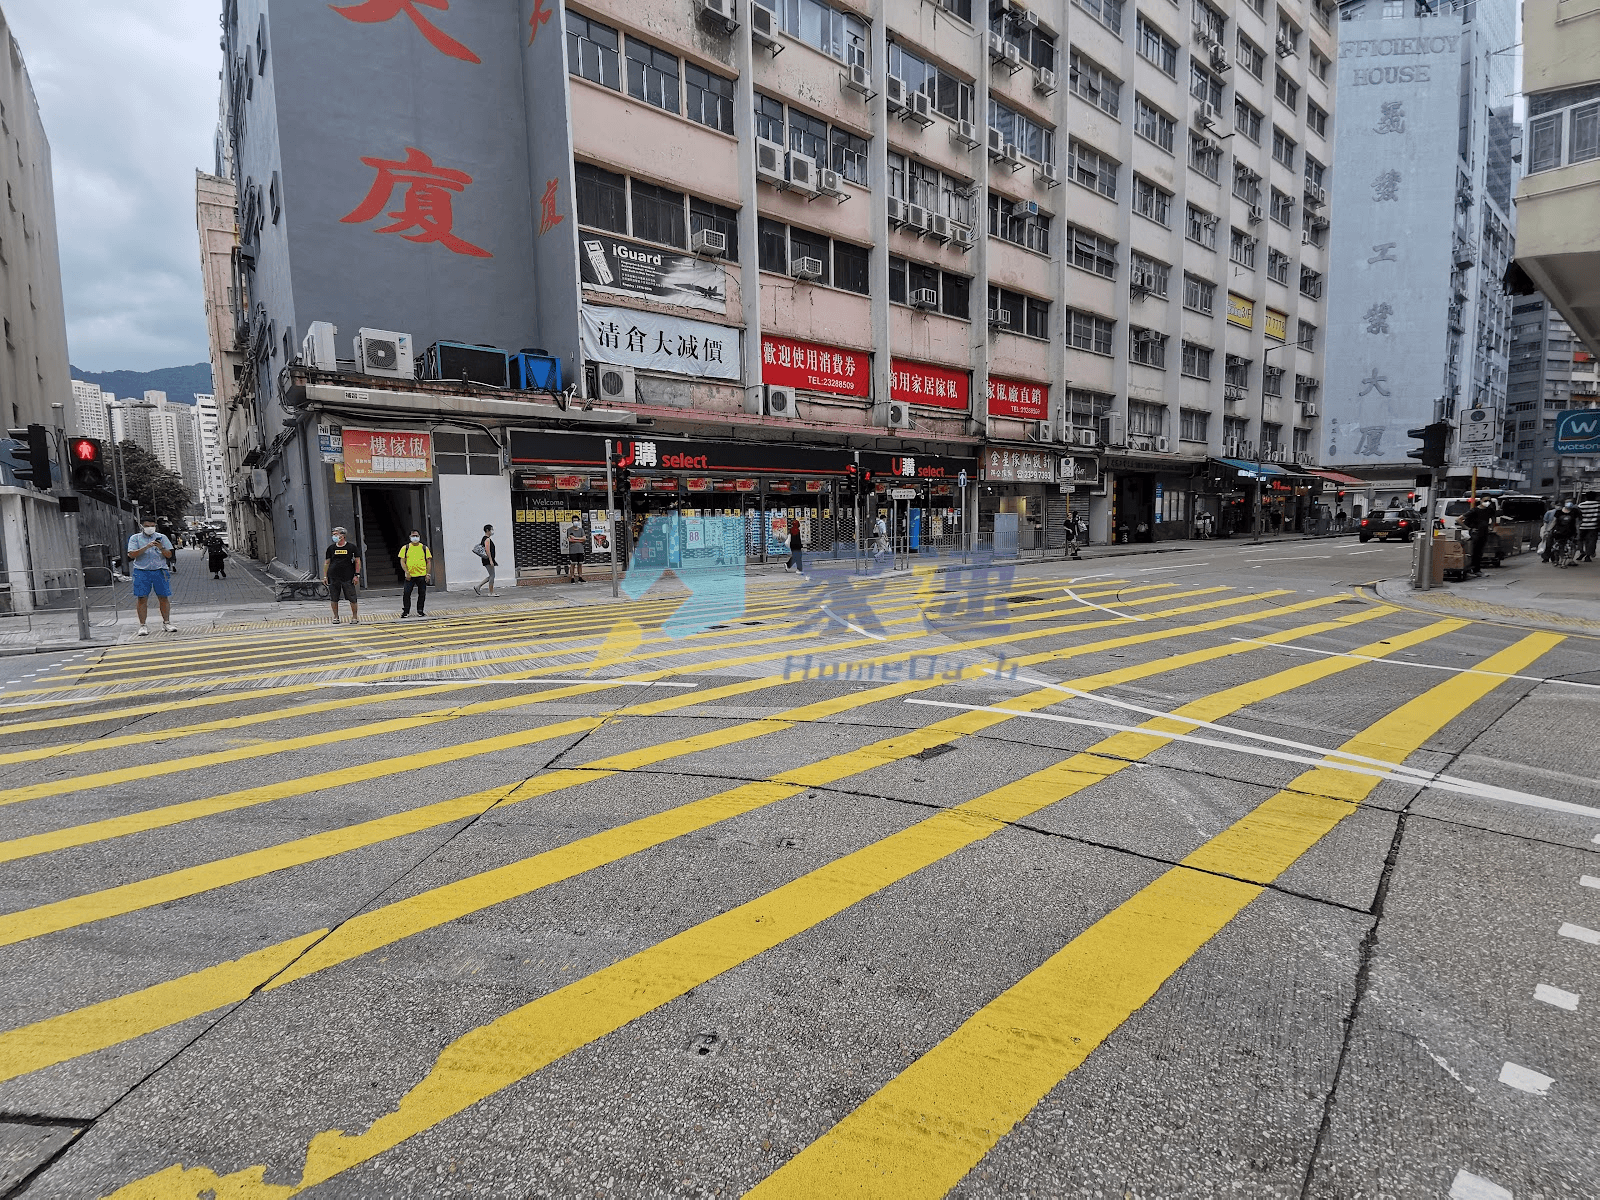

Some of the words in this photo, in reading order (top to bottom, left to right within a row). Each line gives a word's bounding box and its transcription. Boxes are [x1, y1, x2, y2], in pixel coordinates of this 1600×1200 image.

[1338, 35, 1460, 59] FFICIENCY
[1352, 64, 1431, 87] HOUSE
[612, 243, 662, 266] iGuard
[763, 340, 857, 378] 歡迎使用消費券
[349, 435, 426, 457] 一樓傢俬
[661, 452, 708, 469] select
[917, 464, 945, 478] select
[532, 498, 564, 507] Welcome
